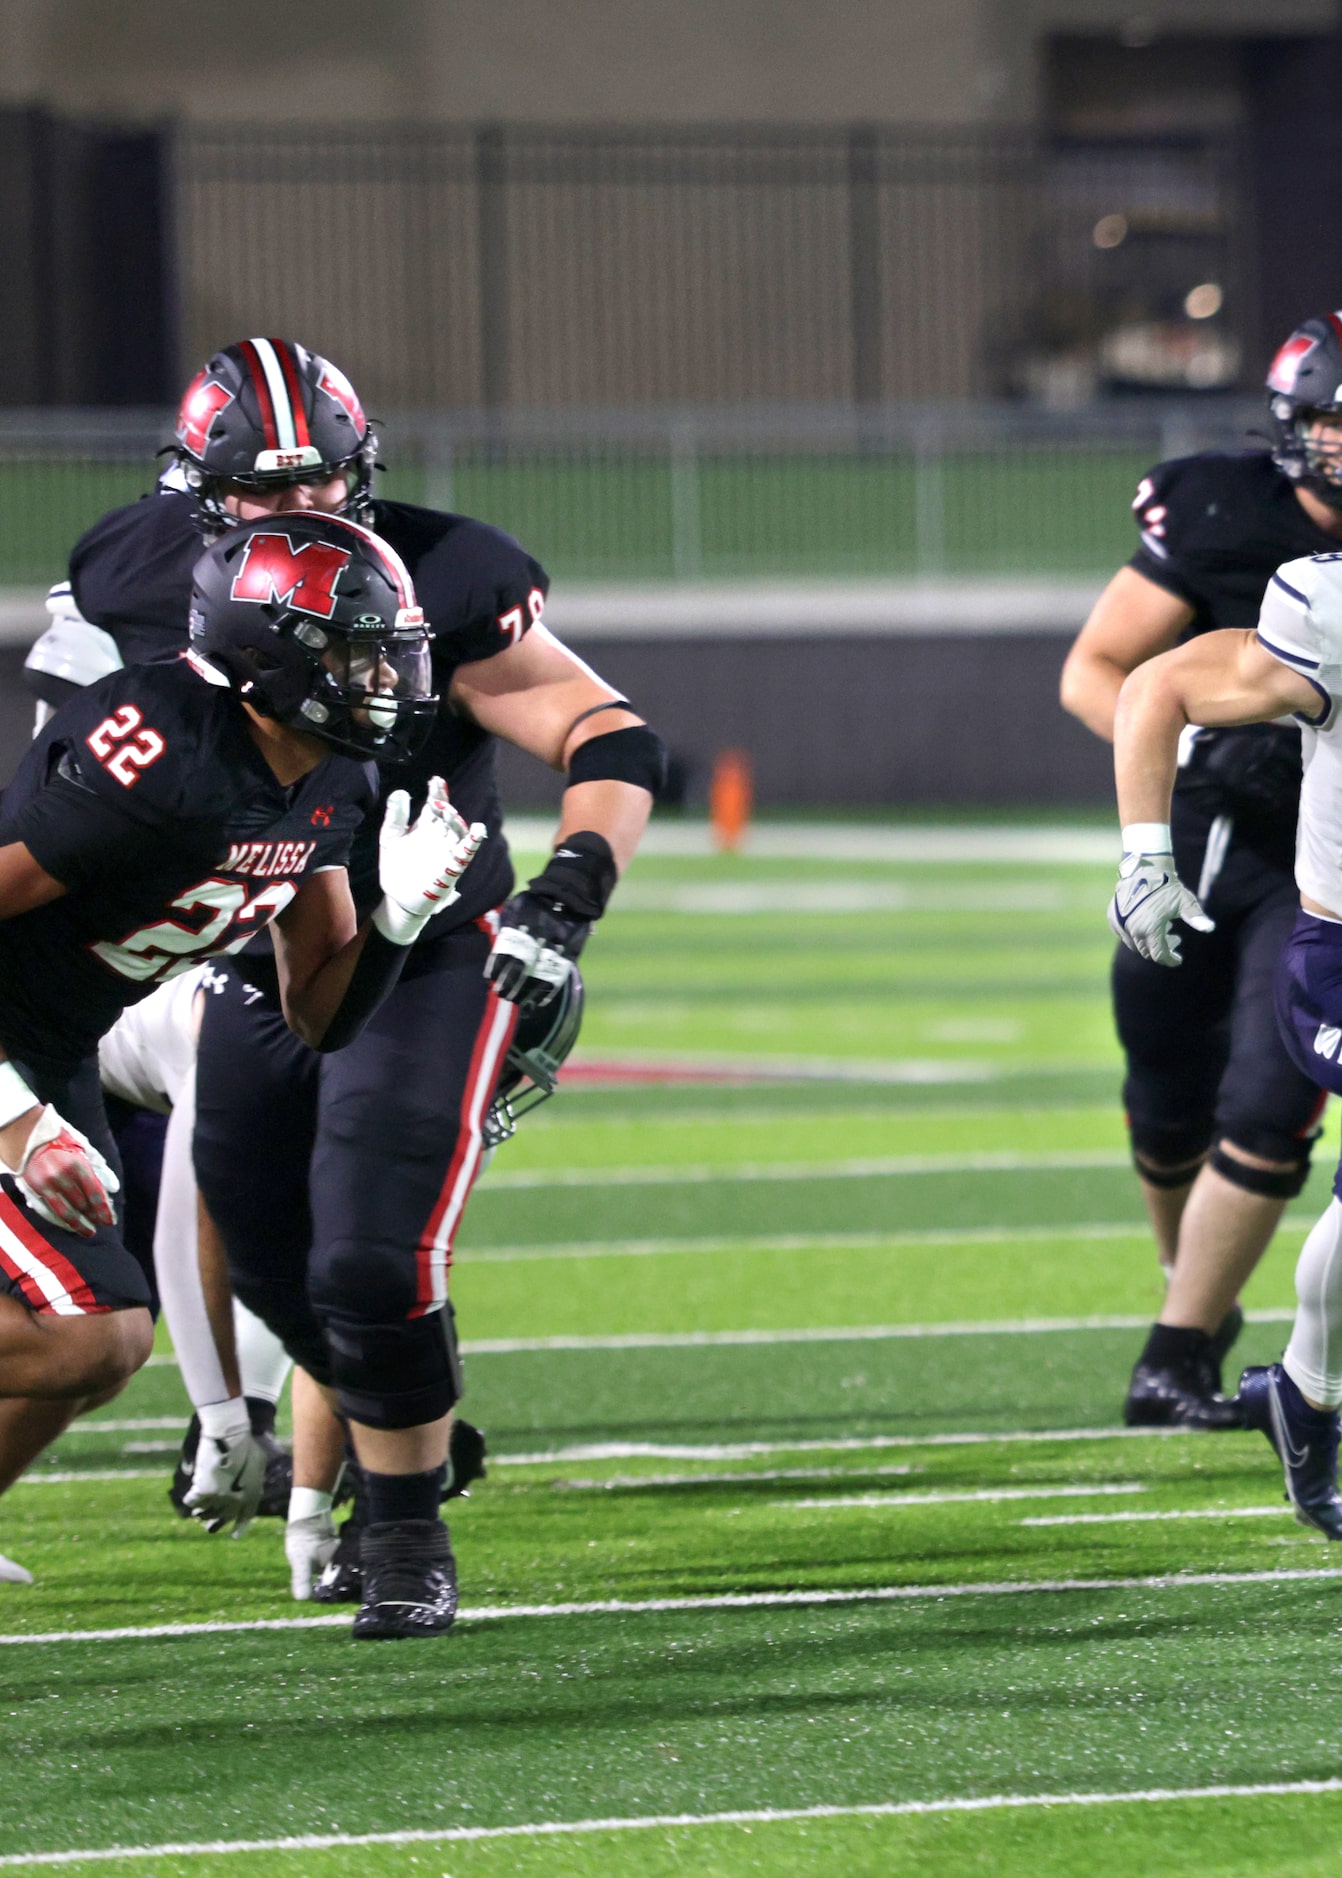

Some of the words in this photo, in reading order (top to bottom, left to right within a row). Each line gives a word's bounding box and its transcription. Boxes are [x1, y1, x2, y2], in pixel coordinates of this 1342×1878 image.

[230, 532, 352, 620] M
[85, 703, 168, 790] 22
[214, 840, 317, 877] MELISSA
